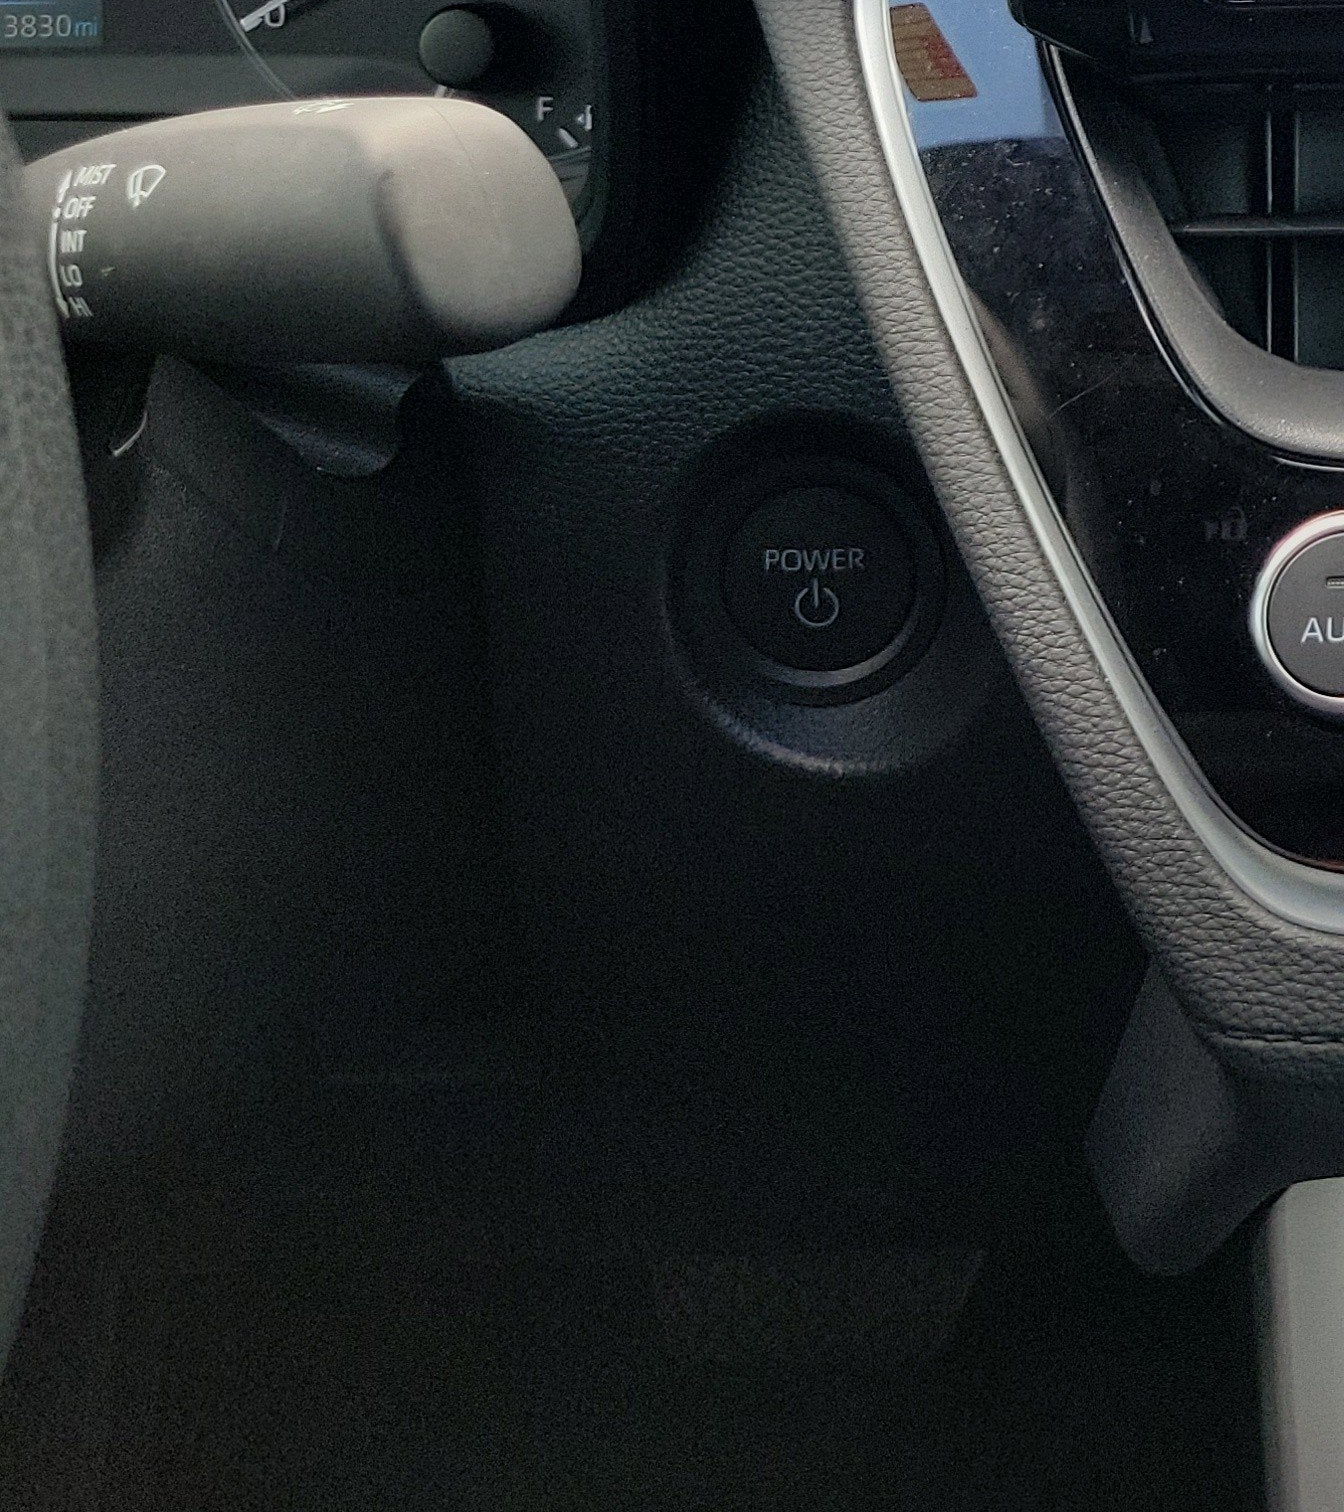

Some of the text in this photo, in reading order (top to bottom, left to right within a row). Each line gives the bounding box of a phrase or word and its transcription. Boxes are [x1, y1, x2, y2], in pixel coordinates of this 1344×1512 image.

[5, 15, 97, 37] 3830 mi
[537, 96, 553, 121] F
[72, 163, 117, 186] MIST
[63, 196, 97, 219] OFF
[60, 230, 87, 253] INT
[60, 264, 83, 287] LO
[765, 549, 865, 572] POWER
